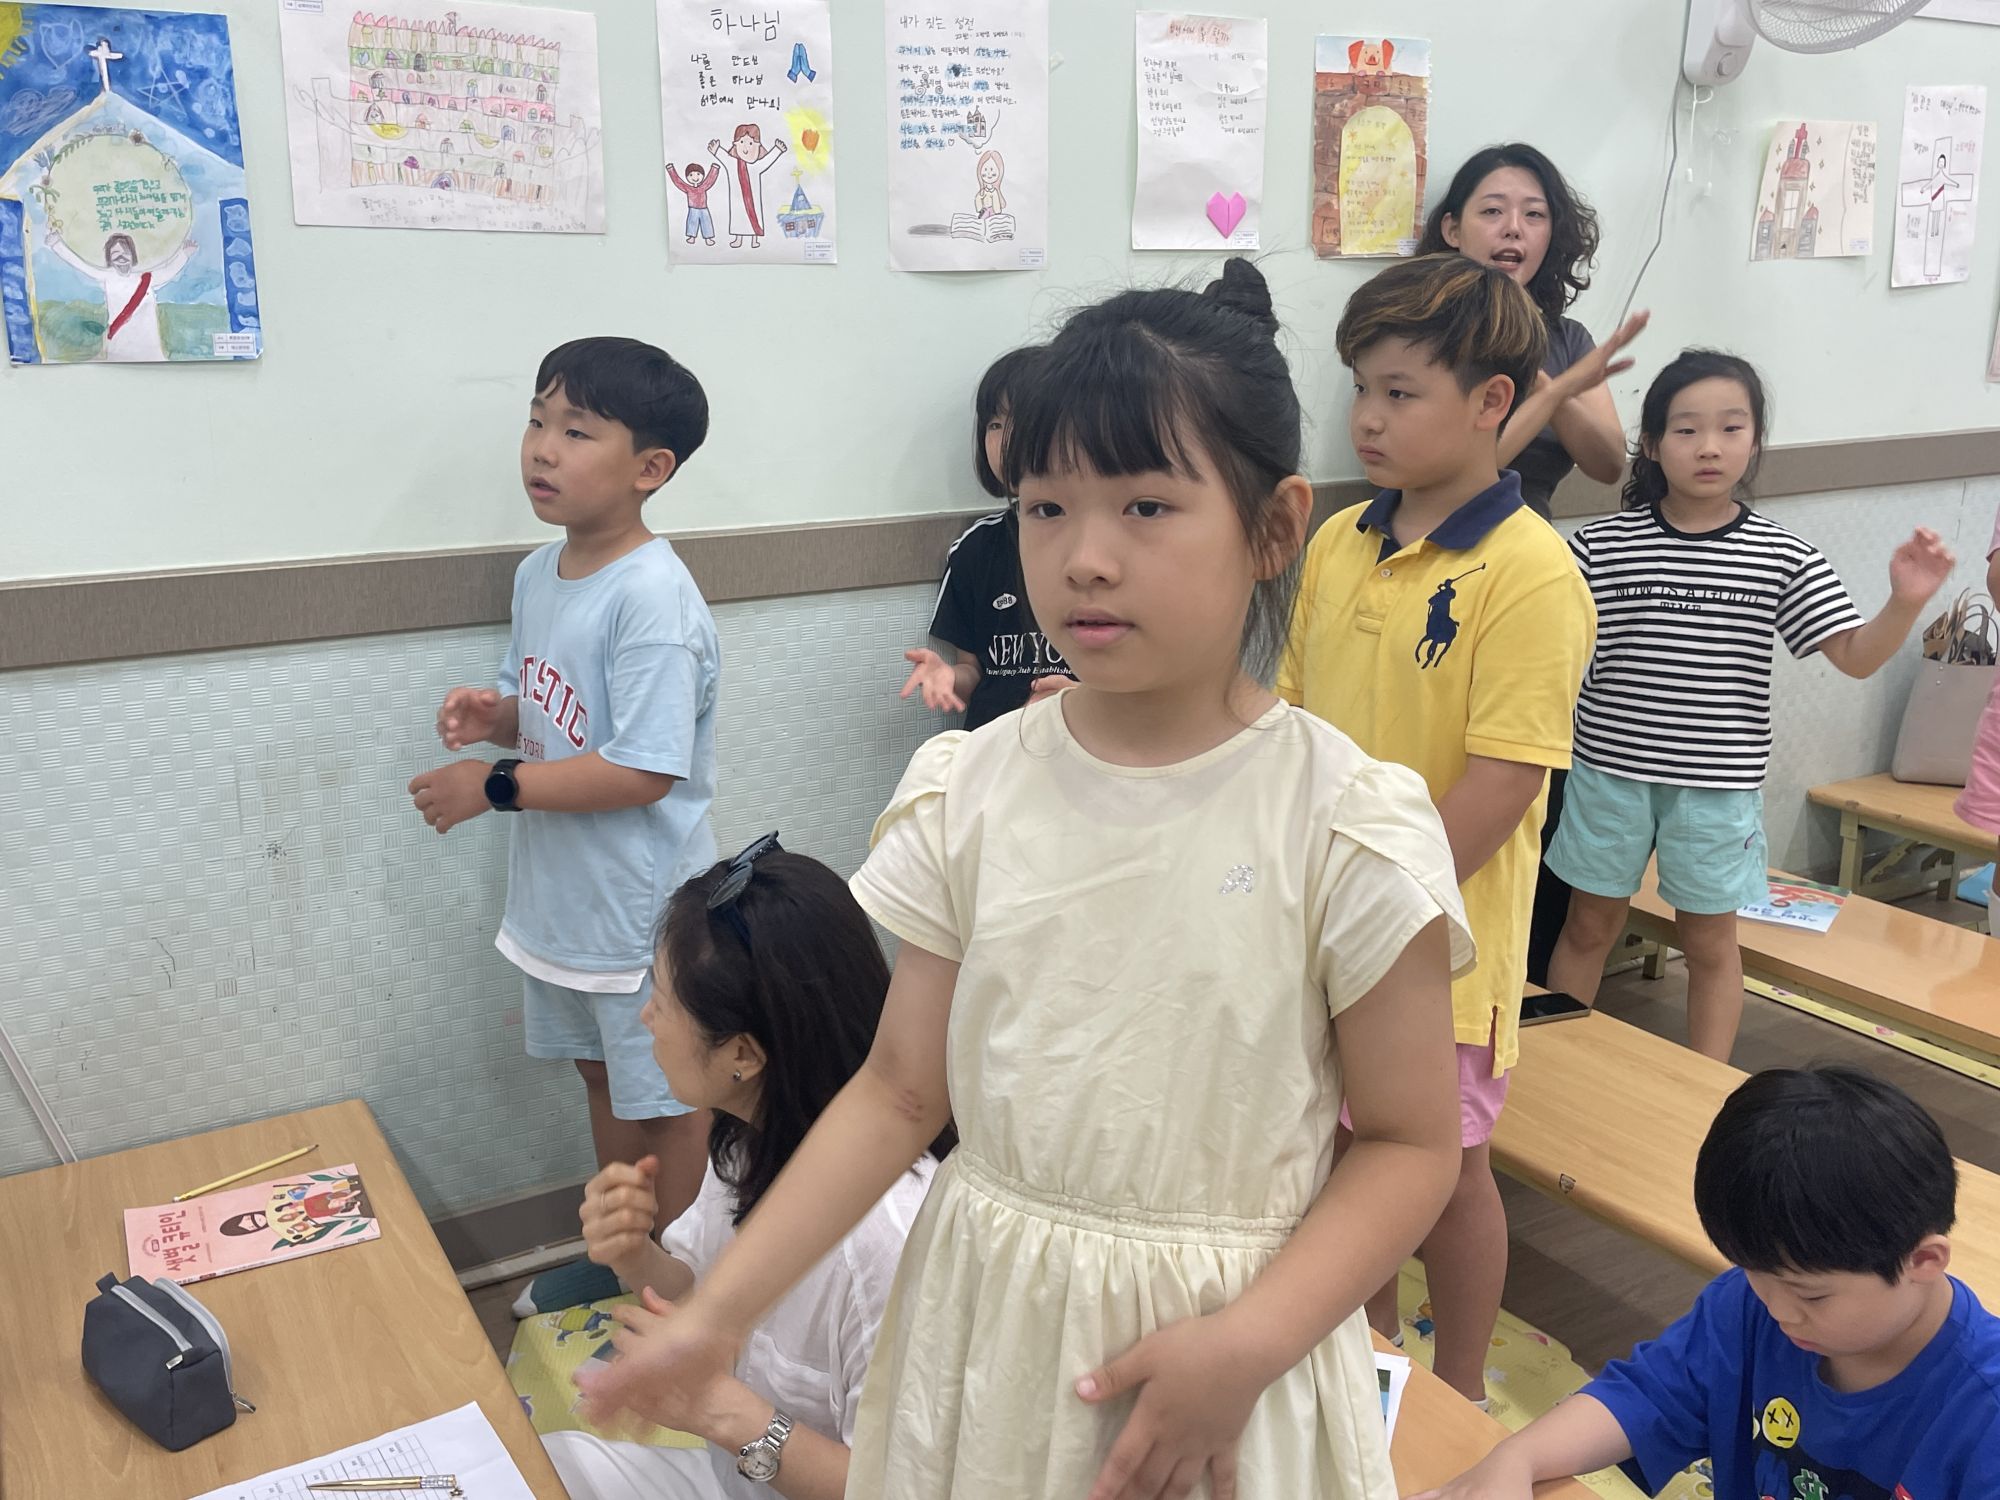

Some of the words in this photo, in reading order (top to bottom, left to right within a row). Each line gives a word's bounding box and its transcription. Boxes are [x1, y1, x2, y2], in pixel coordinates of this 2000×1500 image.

[711, 9, 780, 41] 하나님
[899, 15, 919, 28] 내가
[926, 16, 946, 30] 짓는
[954, 17, 974, 31] 성전
[691, 53, 712, 70] 나를
[732, 55, 758, 66] 만드신
[732, 75, 763, 85] 하나님
[701, 93, 734, 107] 성전에서
[747, 96, 781, 111] 만나요!
[158, 1209, 191, 1244] 큐티인
